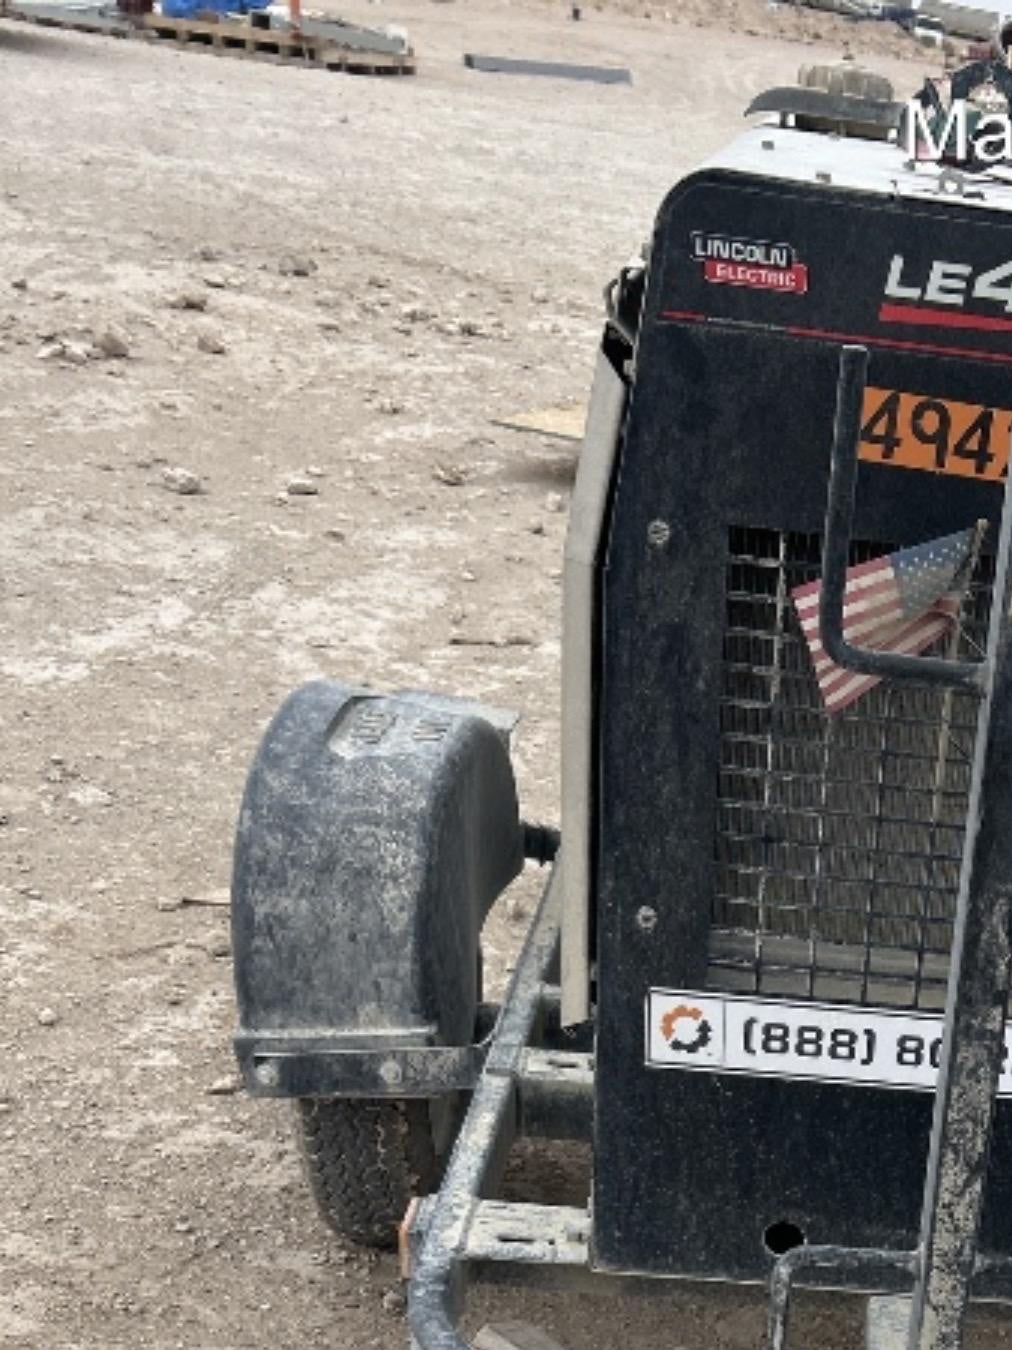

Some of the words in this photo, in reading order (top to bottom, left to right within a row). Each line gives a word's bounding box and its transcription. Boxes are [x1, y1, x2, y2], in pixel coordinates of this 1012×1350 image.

[694, 237, 788, 268] LINCOLN
[715, 263, 797, 287] ELECTRIC
[742, 1016, 876, 1066] (888)
